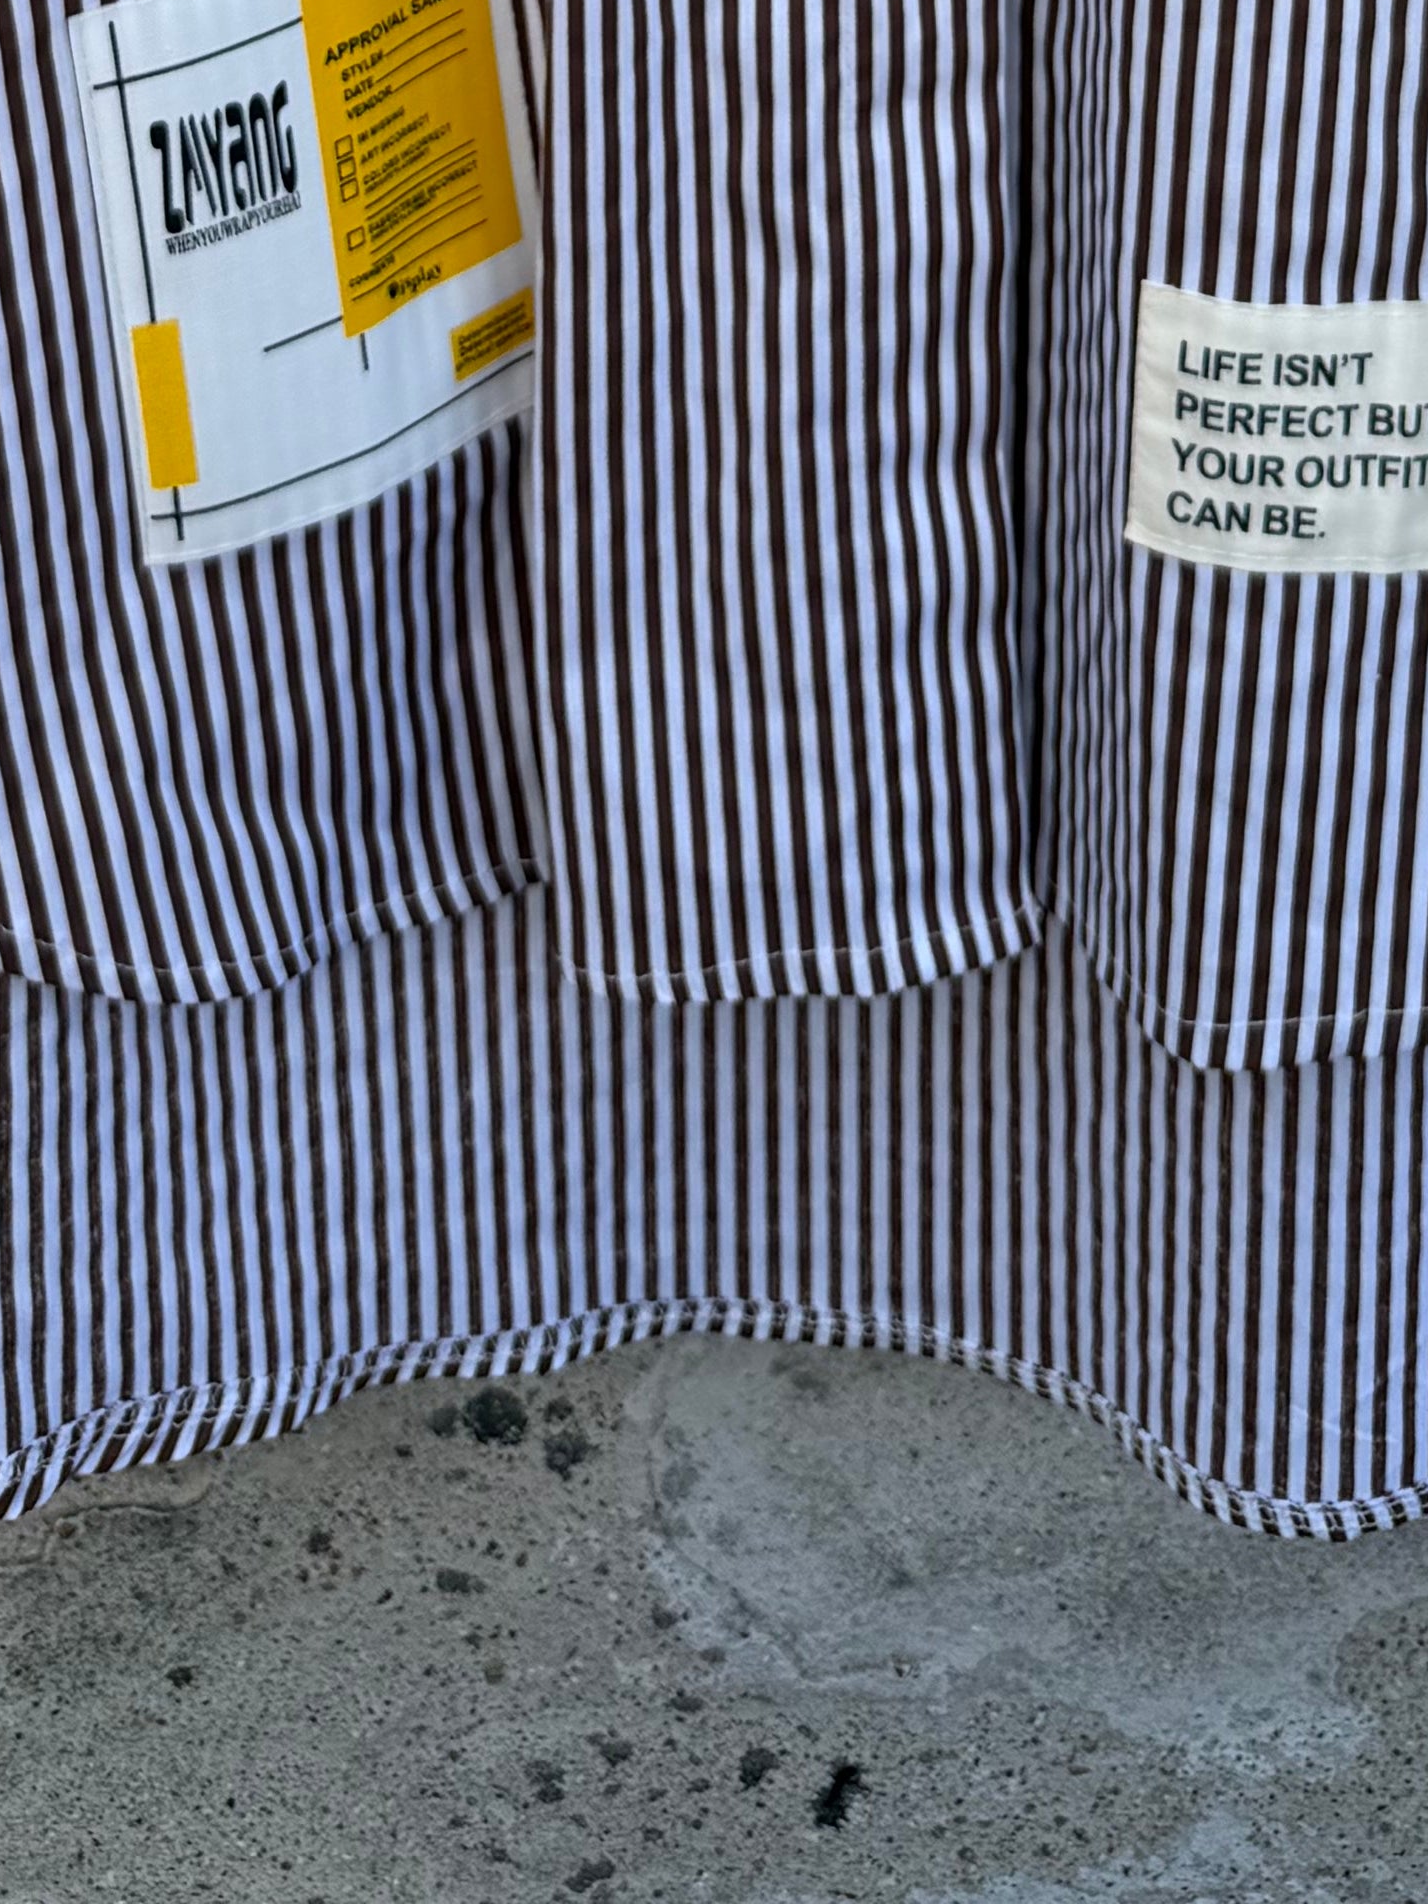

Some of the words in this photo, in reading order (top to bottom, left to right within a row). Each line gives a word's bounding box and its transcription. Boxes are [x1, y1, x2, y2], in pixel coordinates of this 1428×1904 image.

[325, 7, 409, 67] APPROVAL
[343, 75, 374, 102] DATE
[346, 84, 393, 121] VENDOR
[1177, 339, 1263, 386] LIFE
[1273, 352, 1373, 388] ISN'T
[1175, 389, 1359, 439] PERFECT
[1171, 438, 1285, 488] YOUR
[1166, 490, 1251, 534] CAN
[1262, 504, 1326, 540] BE.
